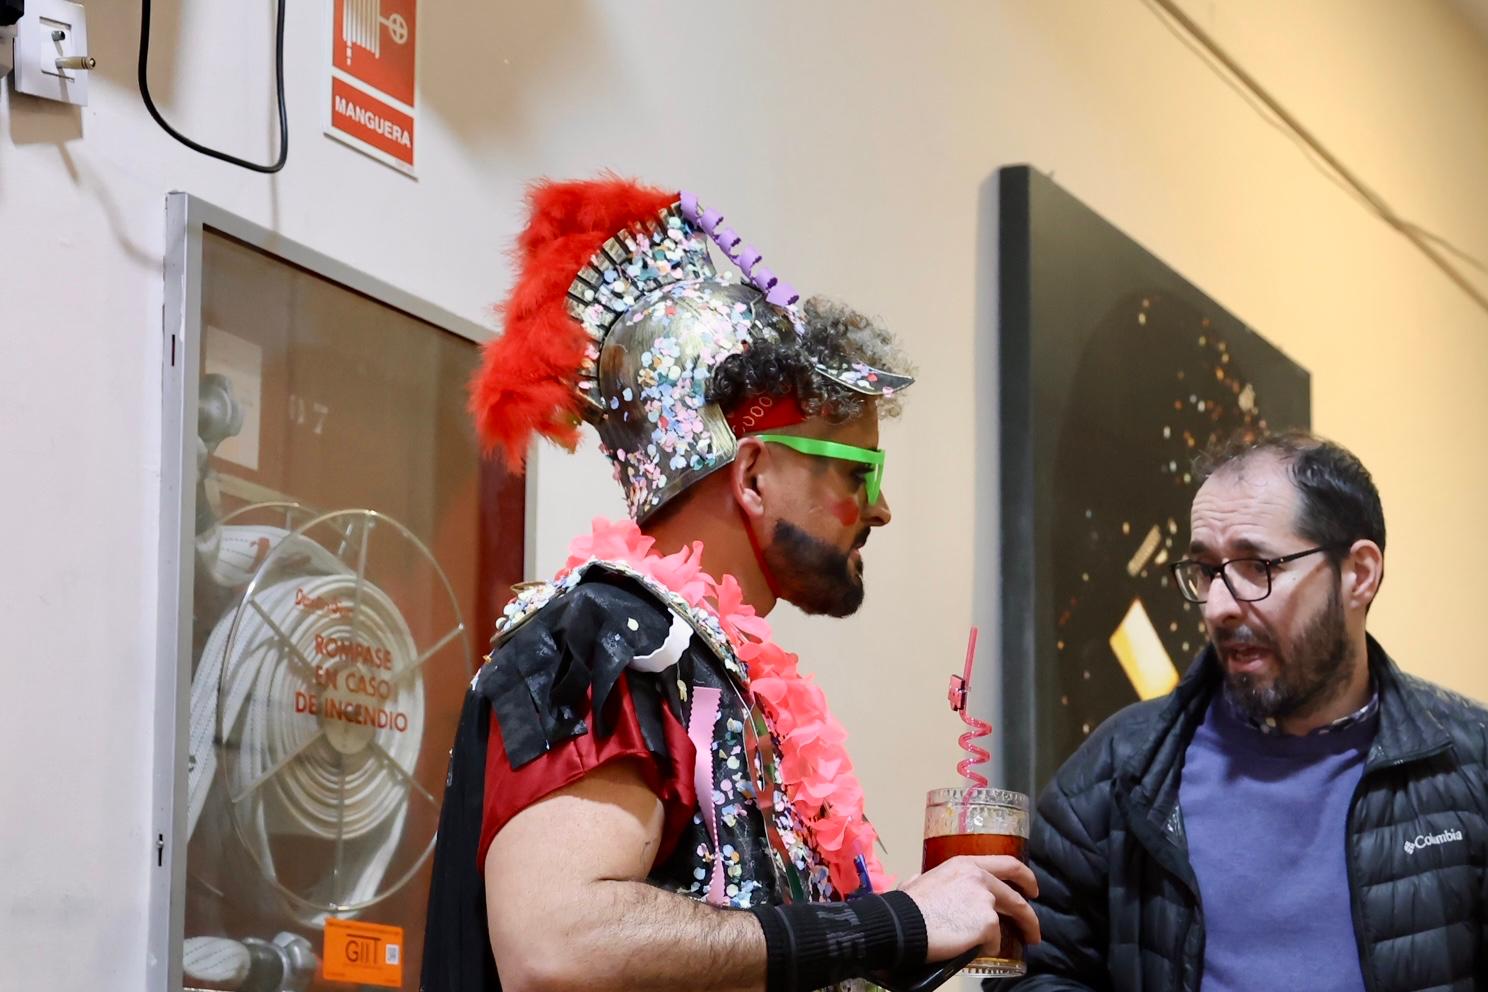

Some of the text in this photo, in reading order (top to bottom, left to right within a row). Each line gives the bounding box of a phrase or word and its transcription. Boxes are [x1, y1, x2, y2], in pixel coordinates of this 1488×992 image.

[335, 95, 411, 148] MANGUERA
[315, 632, 392, 672] ROMPASE
[315, 664, 391, 700] EN CASO
[295, 691, 408, 732] DE INCENDIO
[1415, 829, 1463, 849] Columbia
